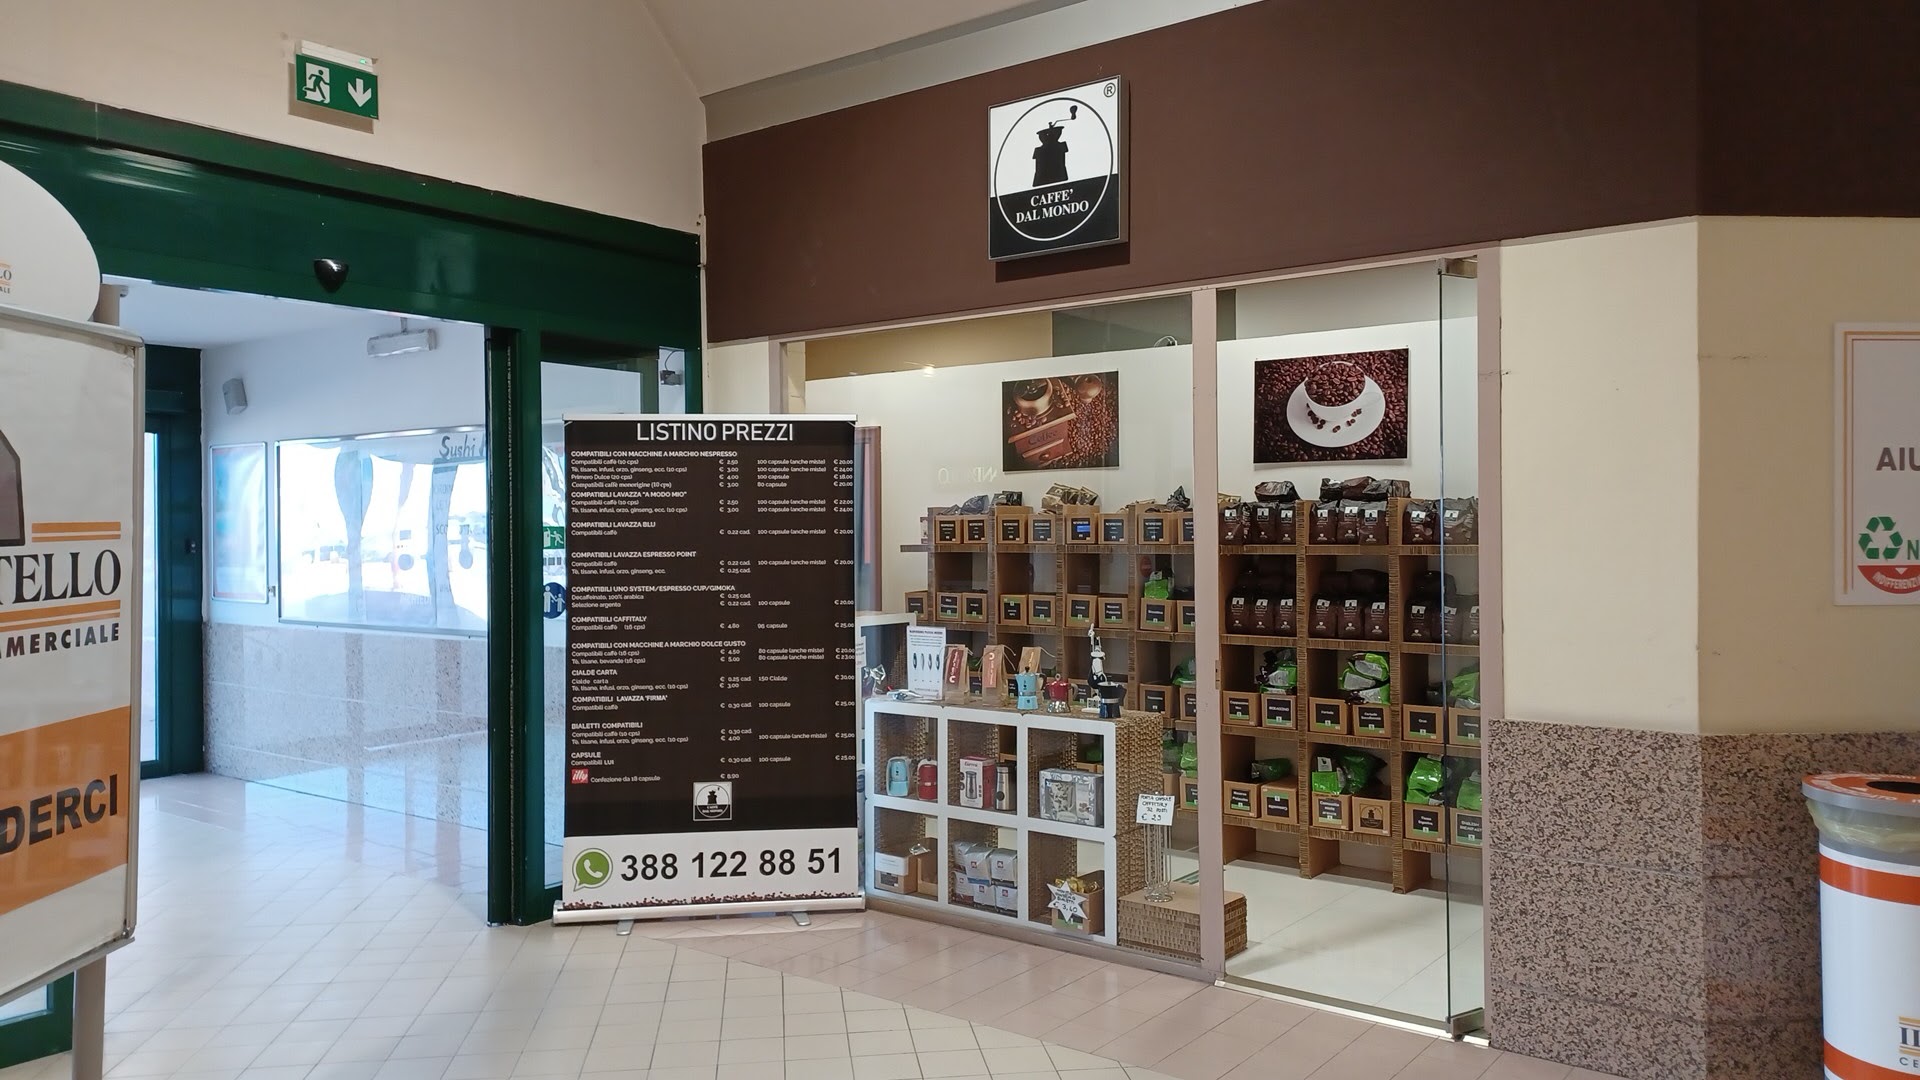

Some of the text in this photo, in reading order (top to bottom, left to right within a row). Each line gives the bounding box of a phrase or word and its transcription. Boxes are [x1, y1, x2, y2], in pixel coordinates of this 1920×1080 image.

[1016, 200, 1089, 224] DAL MONDO
[636, 423, 793, 441] LISTINO PREZZI
[439, 434, 476, 459] Sushi
[0, 622, 120, 659] MERCIALE
[572, 770, 588, 782] illy
[0, 774, 118, 854] DERCI
[621, 848, 840, 882] 388 122 88 51
